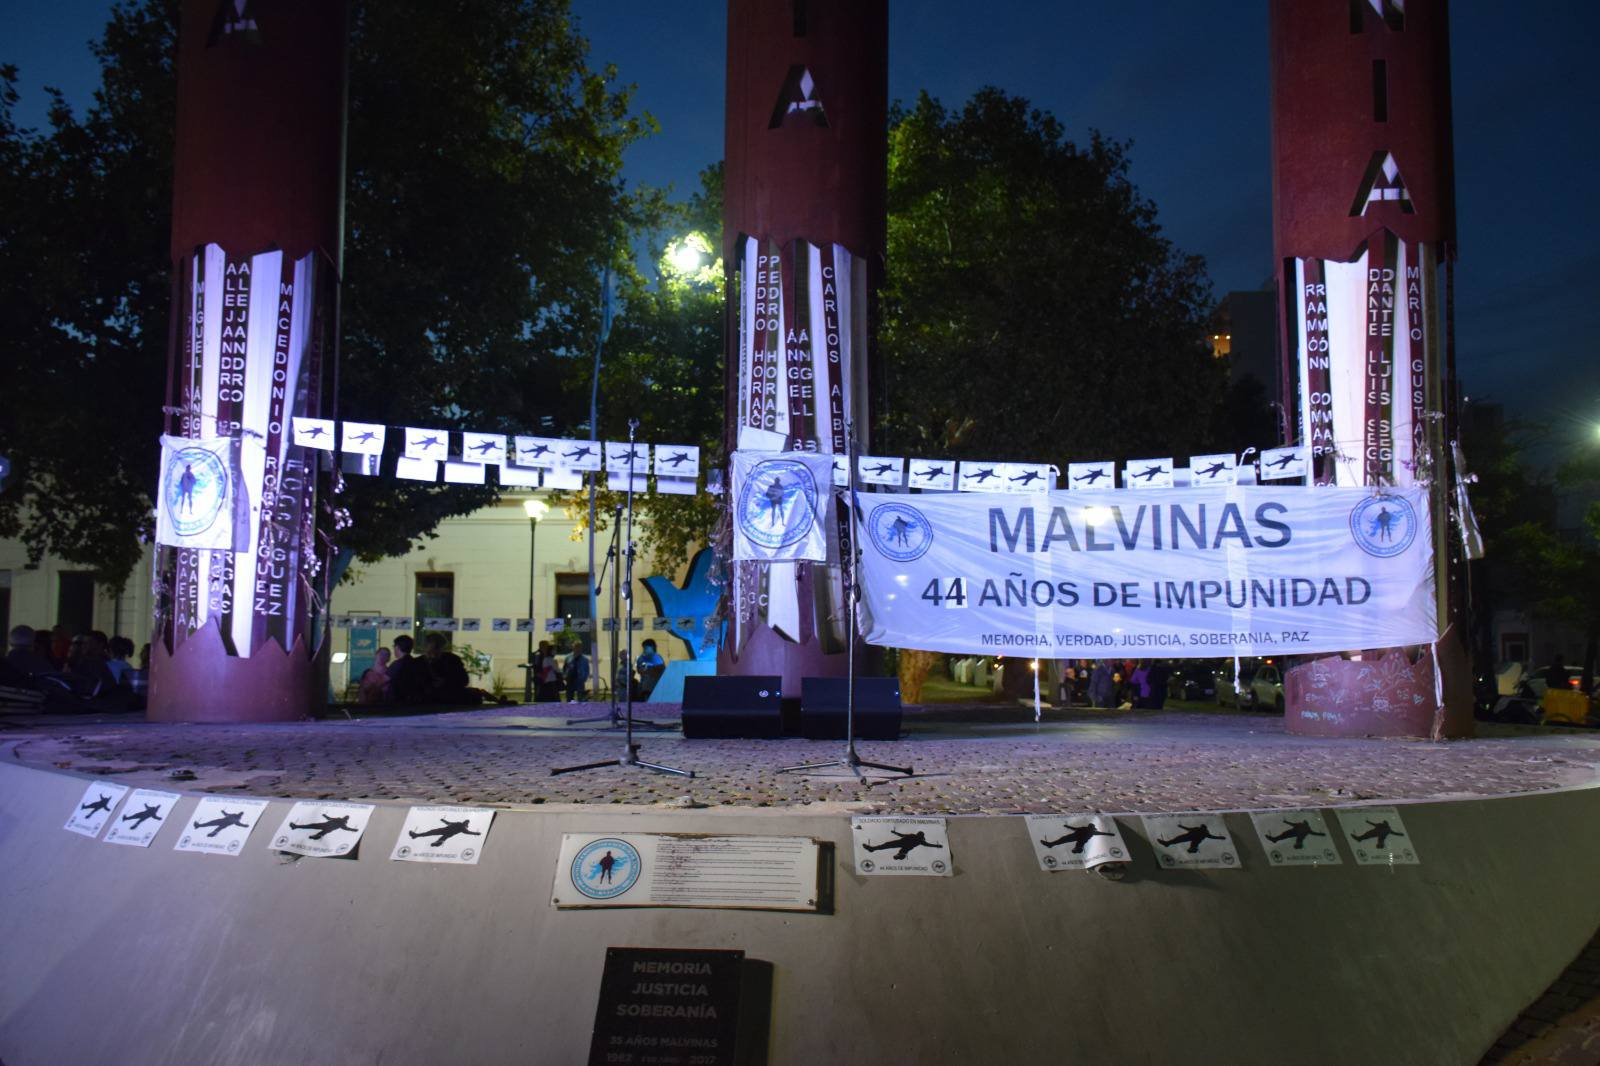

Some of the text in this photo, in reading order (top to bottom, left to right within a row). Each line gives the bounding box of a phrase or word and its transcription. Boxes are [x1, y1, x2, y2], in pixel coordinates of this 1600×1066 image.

[1408, 267, 1422, 340] MARIO
[269, 283, 293, 434] MACEDONIO
[823, 267, 839, 363] CARLOS
[832, 384, 844, 455] ALBE
[988, 502, 1292, 552] MALVINAS
[921, 572, 1371, 609] 44 AÑOS DE IMPUNIDAD
[981, 631, 1310, 647] MEMORIA, VERDAD, JUSTICIA, SOBERANIA, PAZ
[633, 961, 712, 975] MEMORIA
[631, 983, 709, 996] JUSTICIA
[616, 1003, 718, 1019] SOBERANÍA
